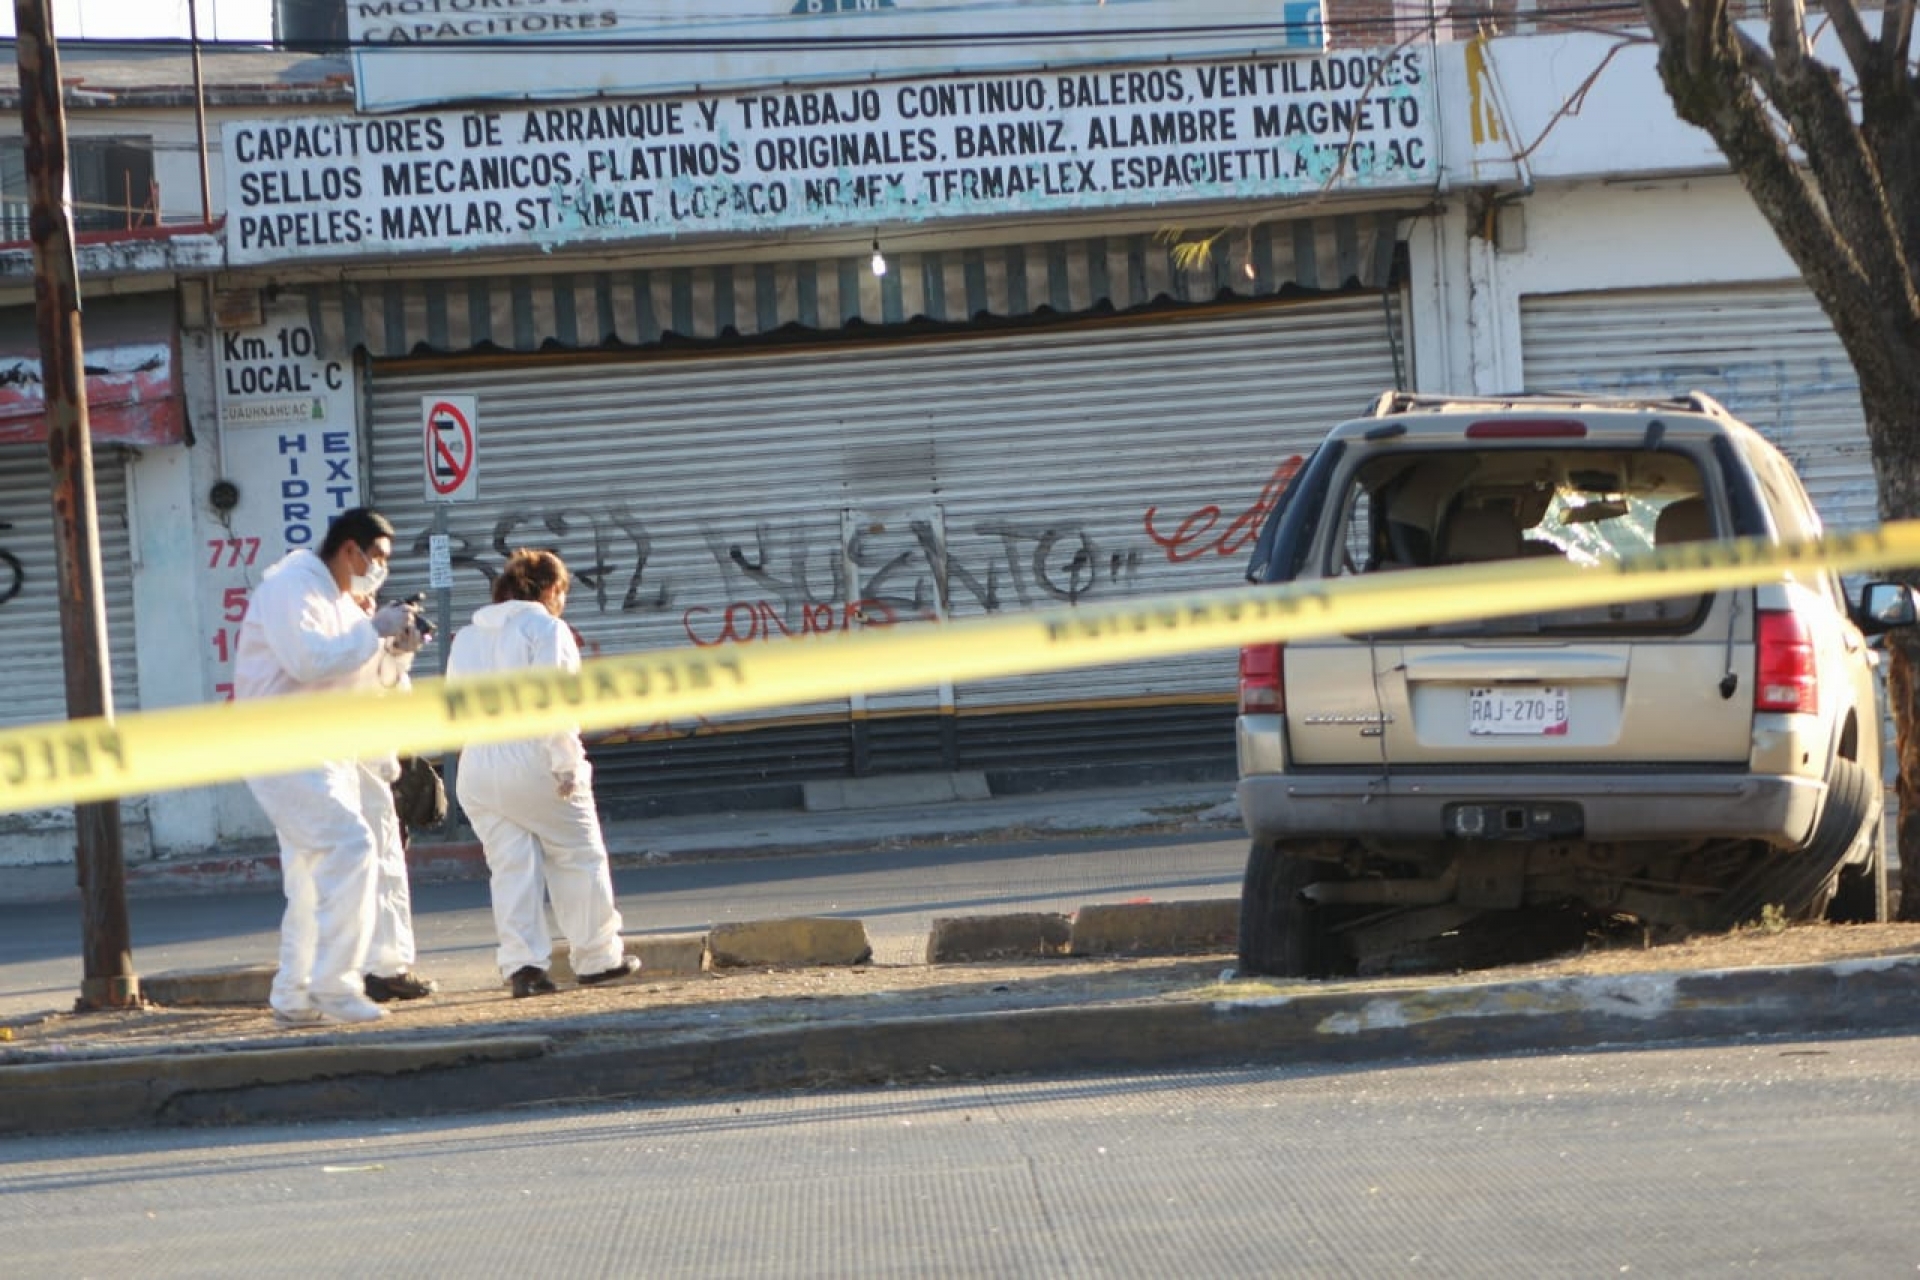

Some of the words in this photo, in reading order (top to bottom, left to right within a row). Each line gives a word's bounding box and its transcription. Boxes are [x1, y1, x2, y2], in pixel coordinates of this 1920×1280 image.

[362, 10, 618, 44] CAPACITORES
[236, 117, 445, 163] CAPACITORES
[462, 113, 502, 148] DE
[522, 102, 684, 143] ARRANQUE
[736, 89, 881, 130] TRABAJO
[1057, 69, 1194, 109] BALEROS,
[1197, 53, 1421, 98] VENTILADORES
[240, 167, 362, 206] SELLOS
[588, 141, 741, 183] PLATINOS
[1088, 108, 1237, 150] ALAMBRE
[1253, 95, 1419, 138] MAGNETO
[239, 209, 373, 249] PAPELES:
[223, 331, 273, 361] Km.
[279, 434, 312, 553] HIDRO
[322, 431, 353, 528] EXT
[207, 537, 261, 568] 777
[212, 628, 241, 663] 1
[1472, 700, 1565, 721] RAJ-270-B
